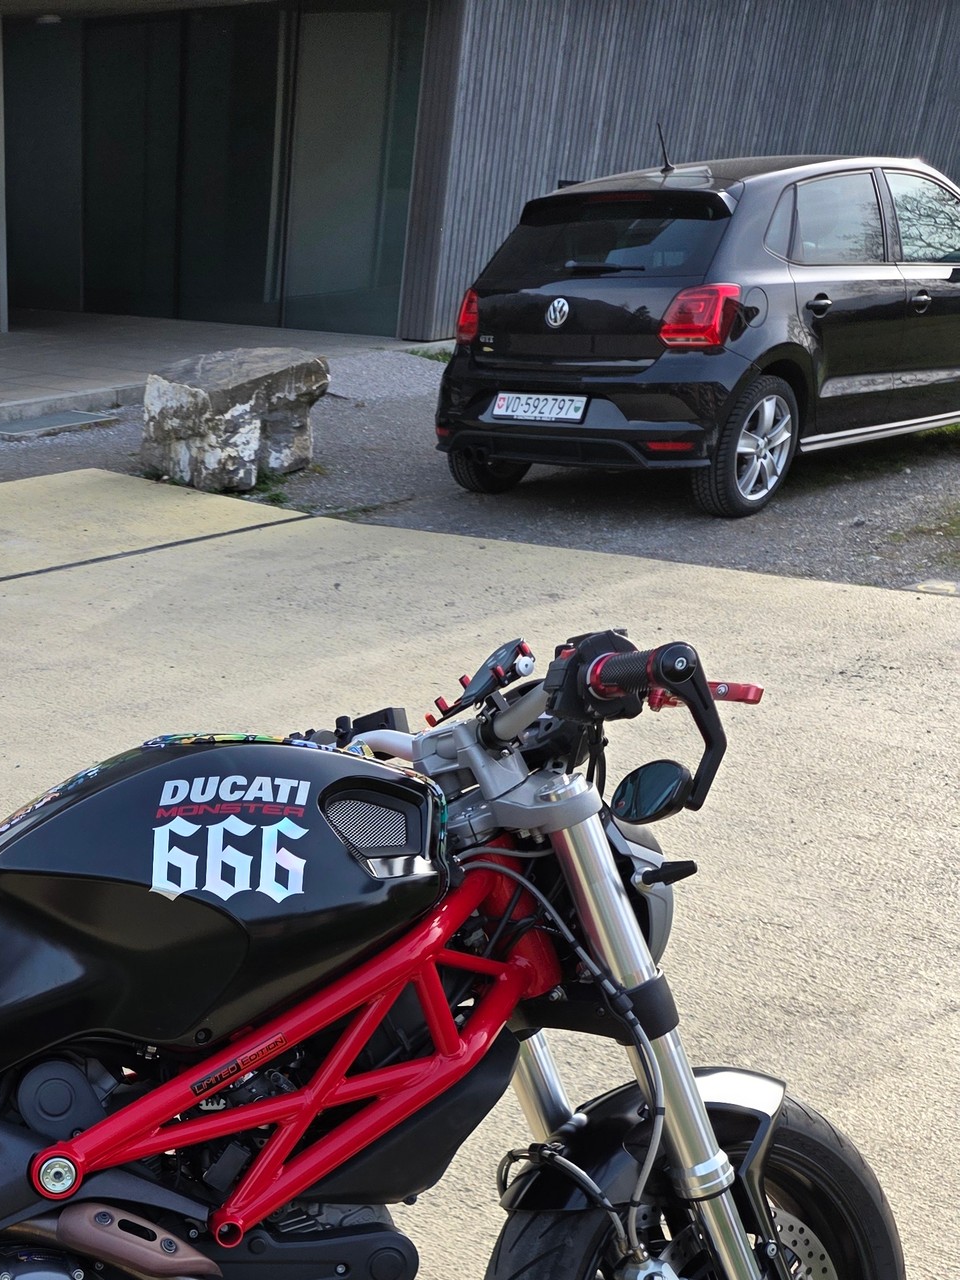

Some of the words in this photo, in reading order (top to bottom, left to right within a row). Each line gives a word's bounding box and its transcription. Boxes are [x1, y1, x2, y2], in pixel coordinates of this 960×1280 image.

[155, 803, 305, 818] MONSTER
[159, 775, 311, 806] DUCATI
[148, 814, 309, 903] 666
[193, 1063, 238, 1094] LIMITED
[241, 1038, 285, 1067] EDITION
